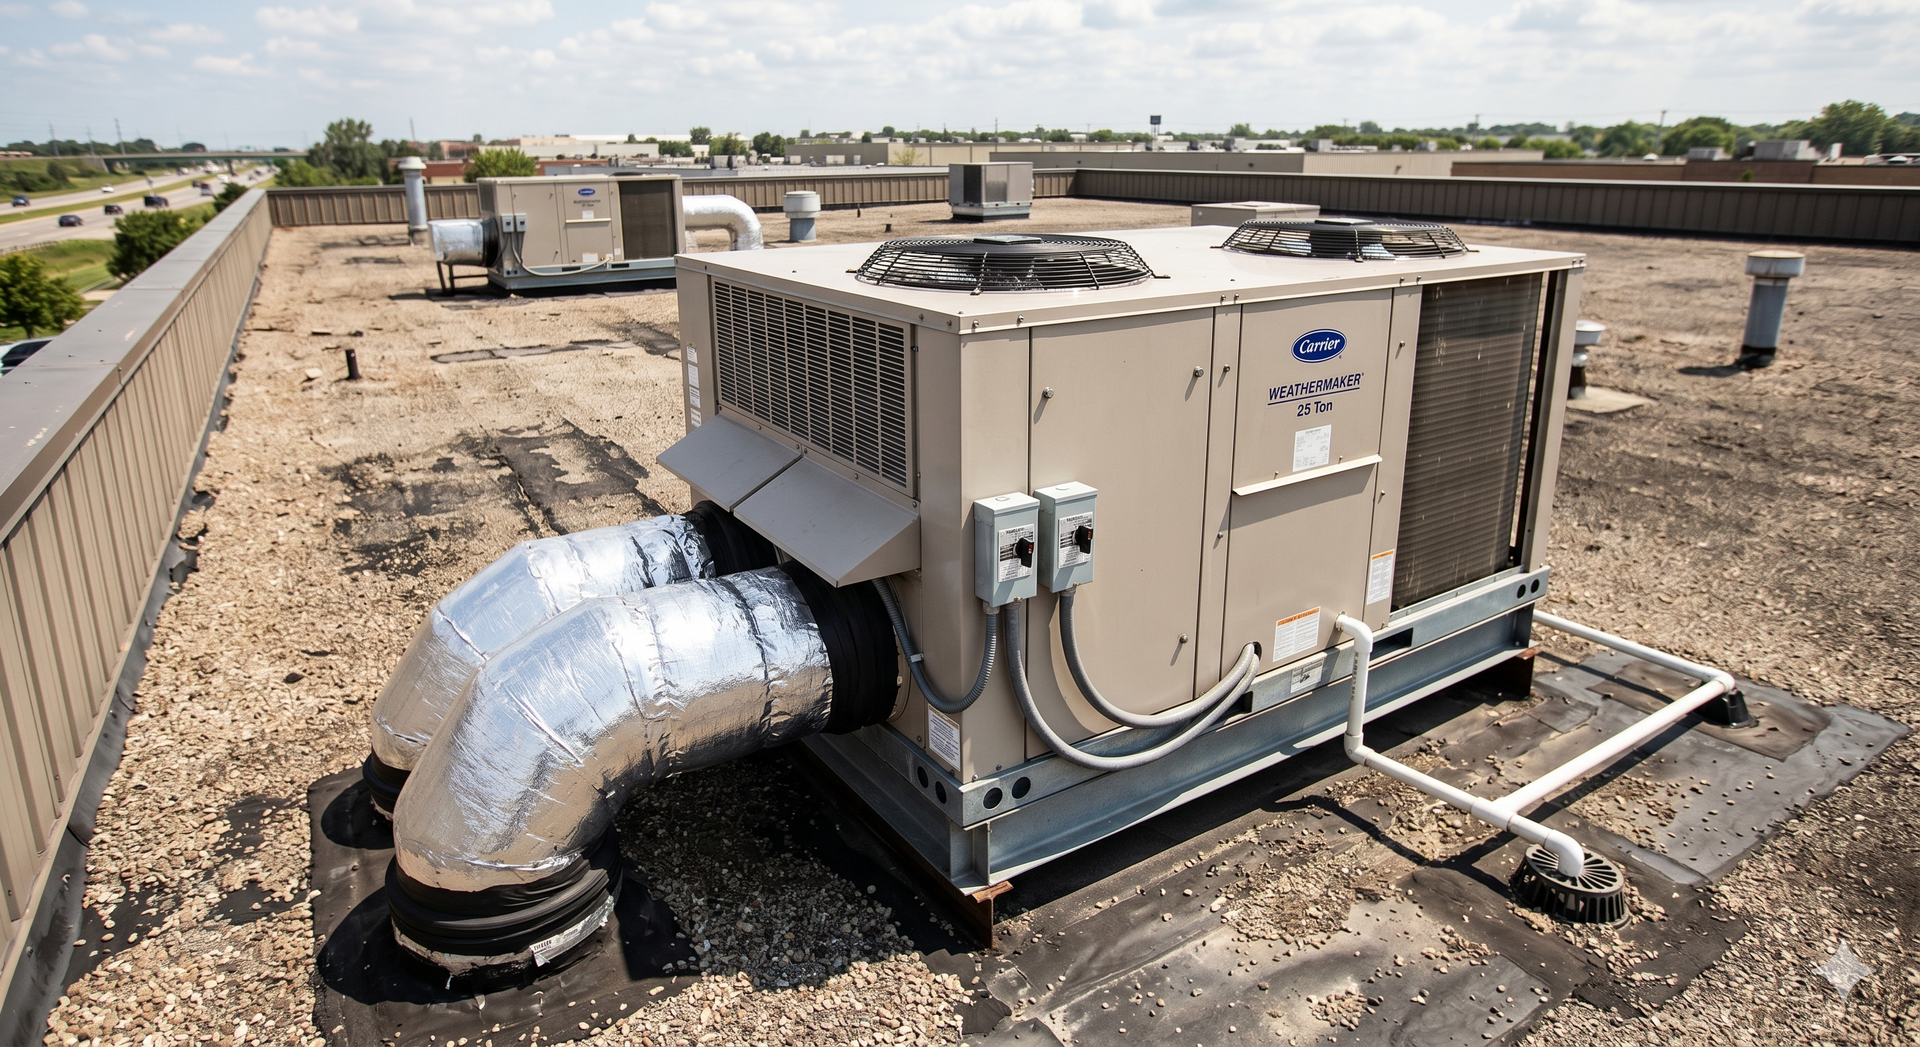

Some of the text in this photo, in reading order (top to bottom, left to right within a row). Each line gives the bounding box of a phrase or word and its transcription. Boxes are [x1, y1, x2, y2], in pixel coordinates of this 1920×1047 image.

[1299, 337, 1341, 354] Carrier
[1269, 373, 1361, 401] WEATHERMAKER
[1296, 401, 1333, 417] 25 Ton
